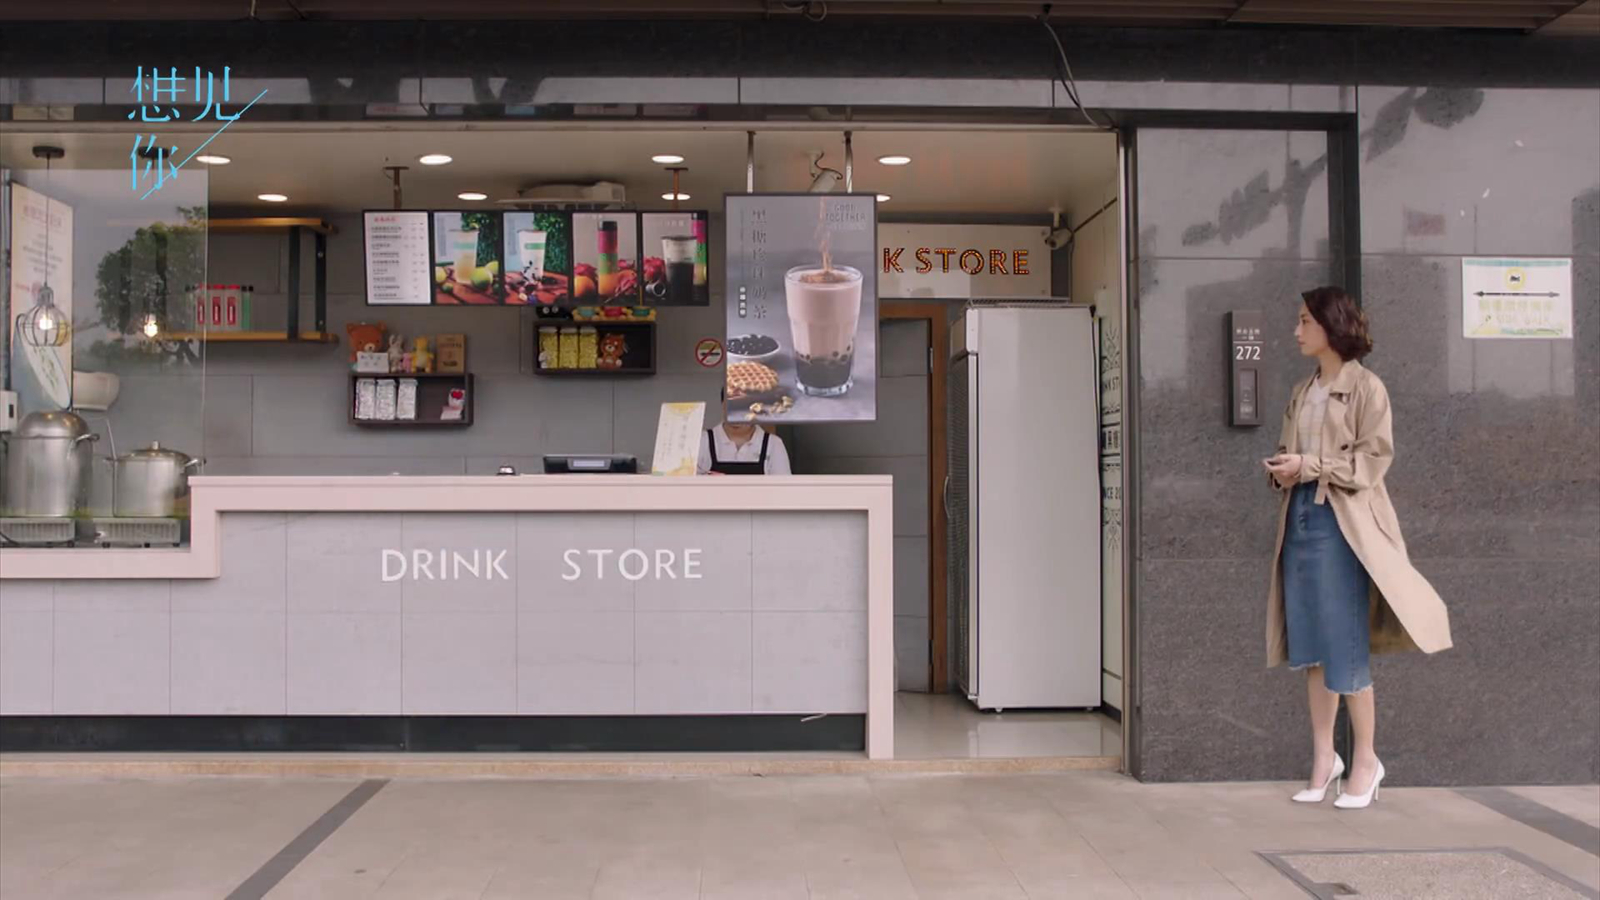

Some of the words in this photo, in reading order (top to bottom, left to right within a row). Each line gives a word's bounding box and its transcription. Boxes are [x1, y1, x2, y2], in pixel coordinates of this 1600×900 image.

[825, 213, 866, 222] TOGETHER
[915, 248, 1029, 275] STORE
[1235, 345, 1261, 360] 272
[381, 549, 509, 581] DRINK
[561, 549, 703, 581] STORE
